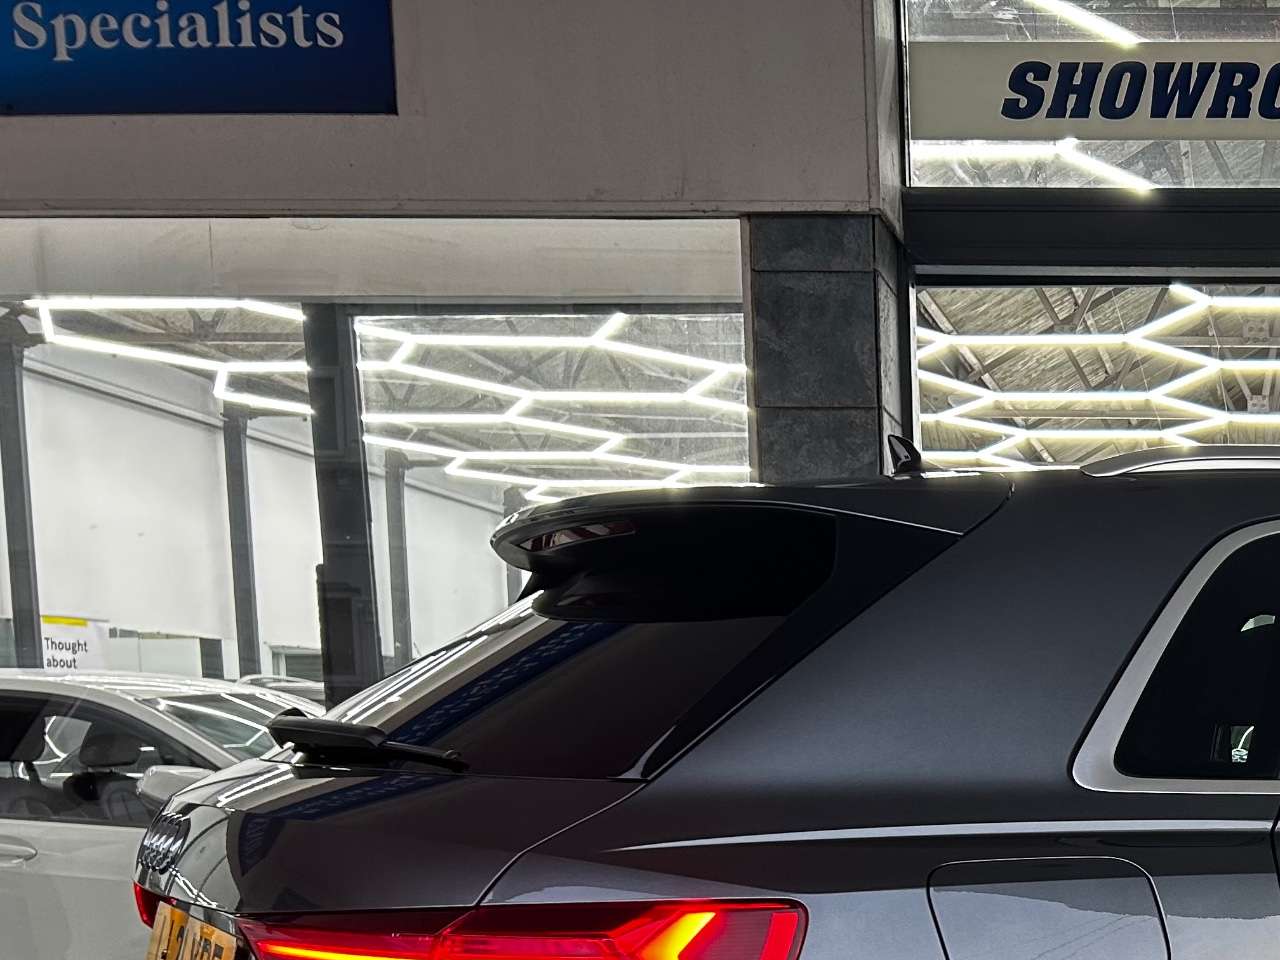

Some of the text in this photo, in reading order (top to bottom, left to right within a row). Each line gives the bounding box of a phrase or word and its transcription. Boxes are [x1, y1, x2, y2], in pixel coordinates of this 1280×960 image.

[11, 0, 345, 62] Specialists
[44, 637, 88, 655] Thought
[46, 656, 77, 669] about
